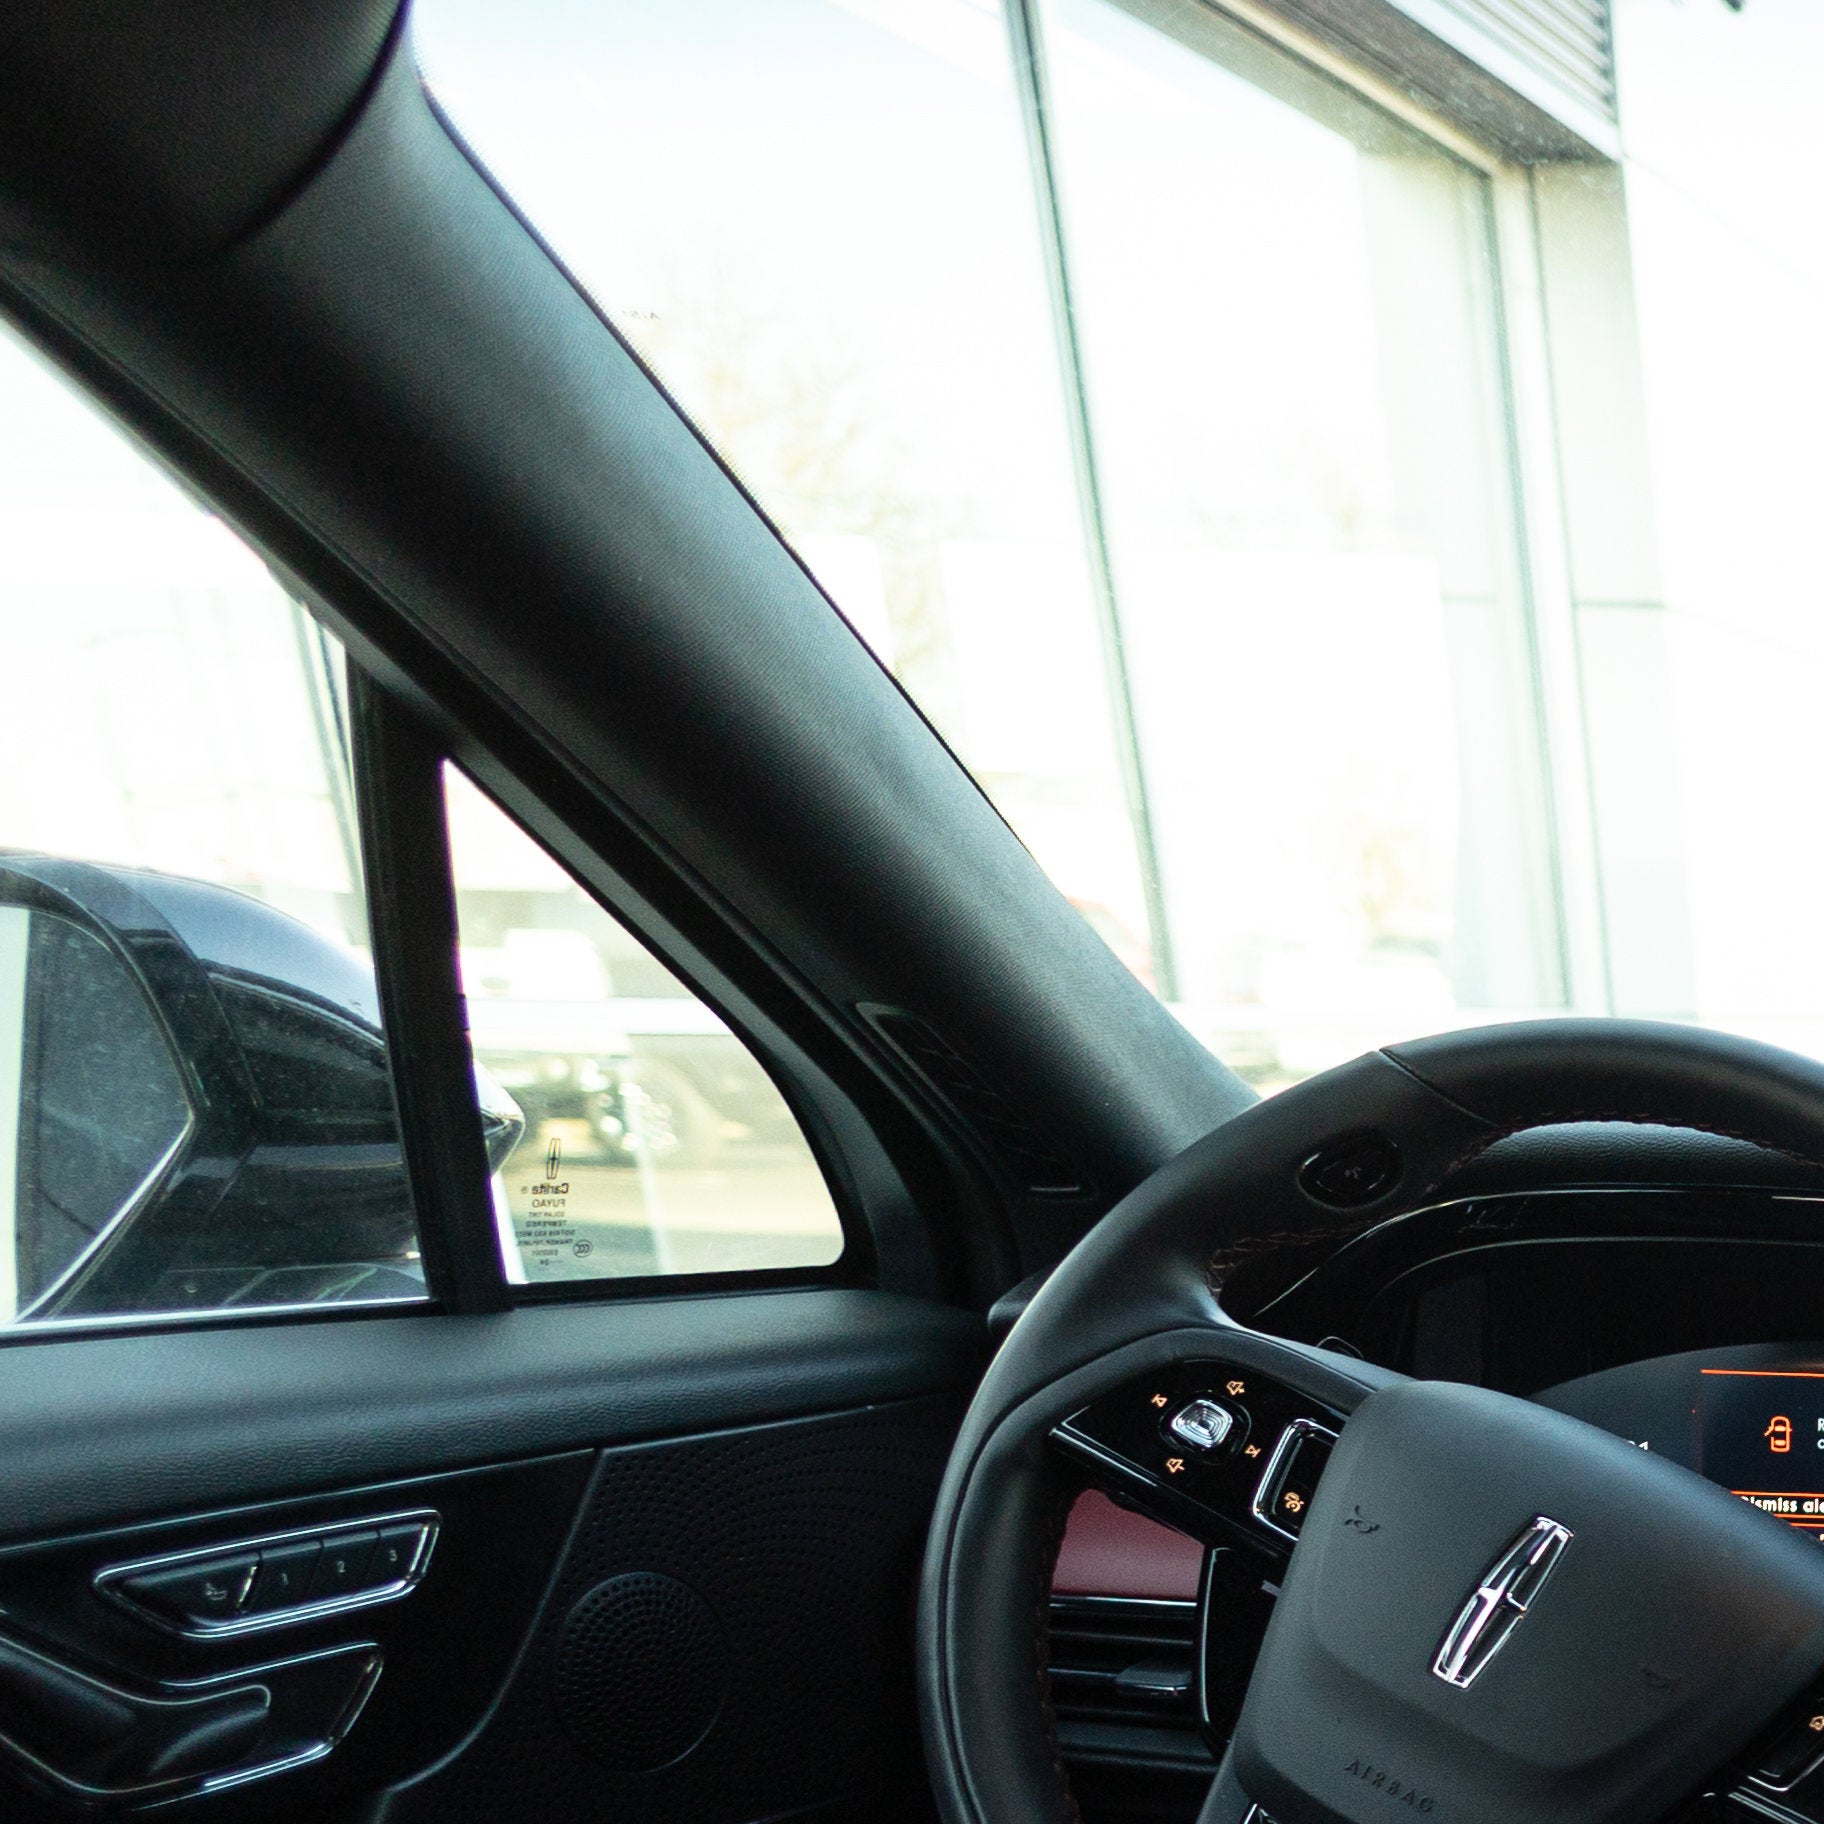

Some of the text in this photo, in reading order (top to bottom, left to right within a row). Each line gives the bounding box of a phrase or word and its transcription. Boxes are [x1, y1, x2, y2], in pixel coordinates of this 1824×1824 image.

[1741, 1495, 1798, 1513] smiss
[390, 1549, 397, 1562] 3
[337, 1560, 346, 1573] 2
[1344, 1759, 1434, 1813] AIRBAG
